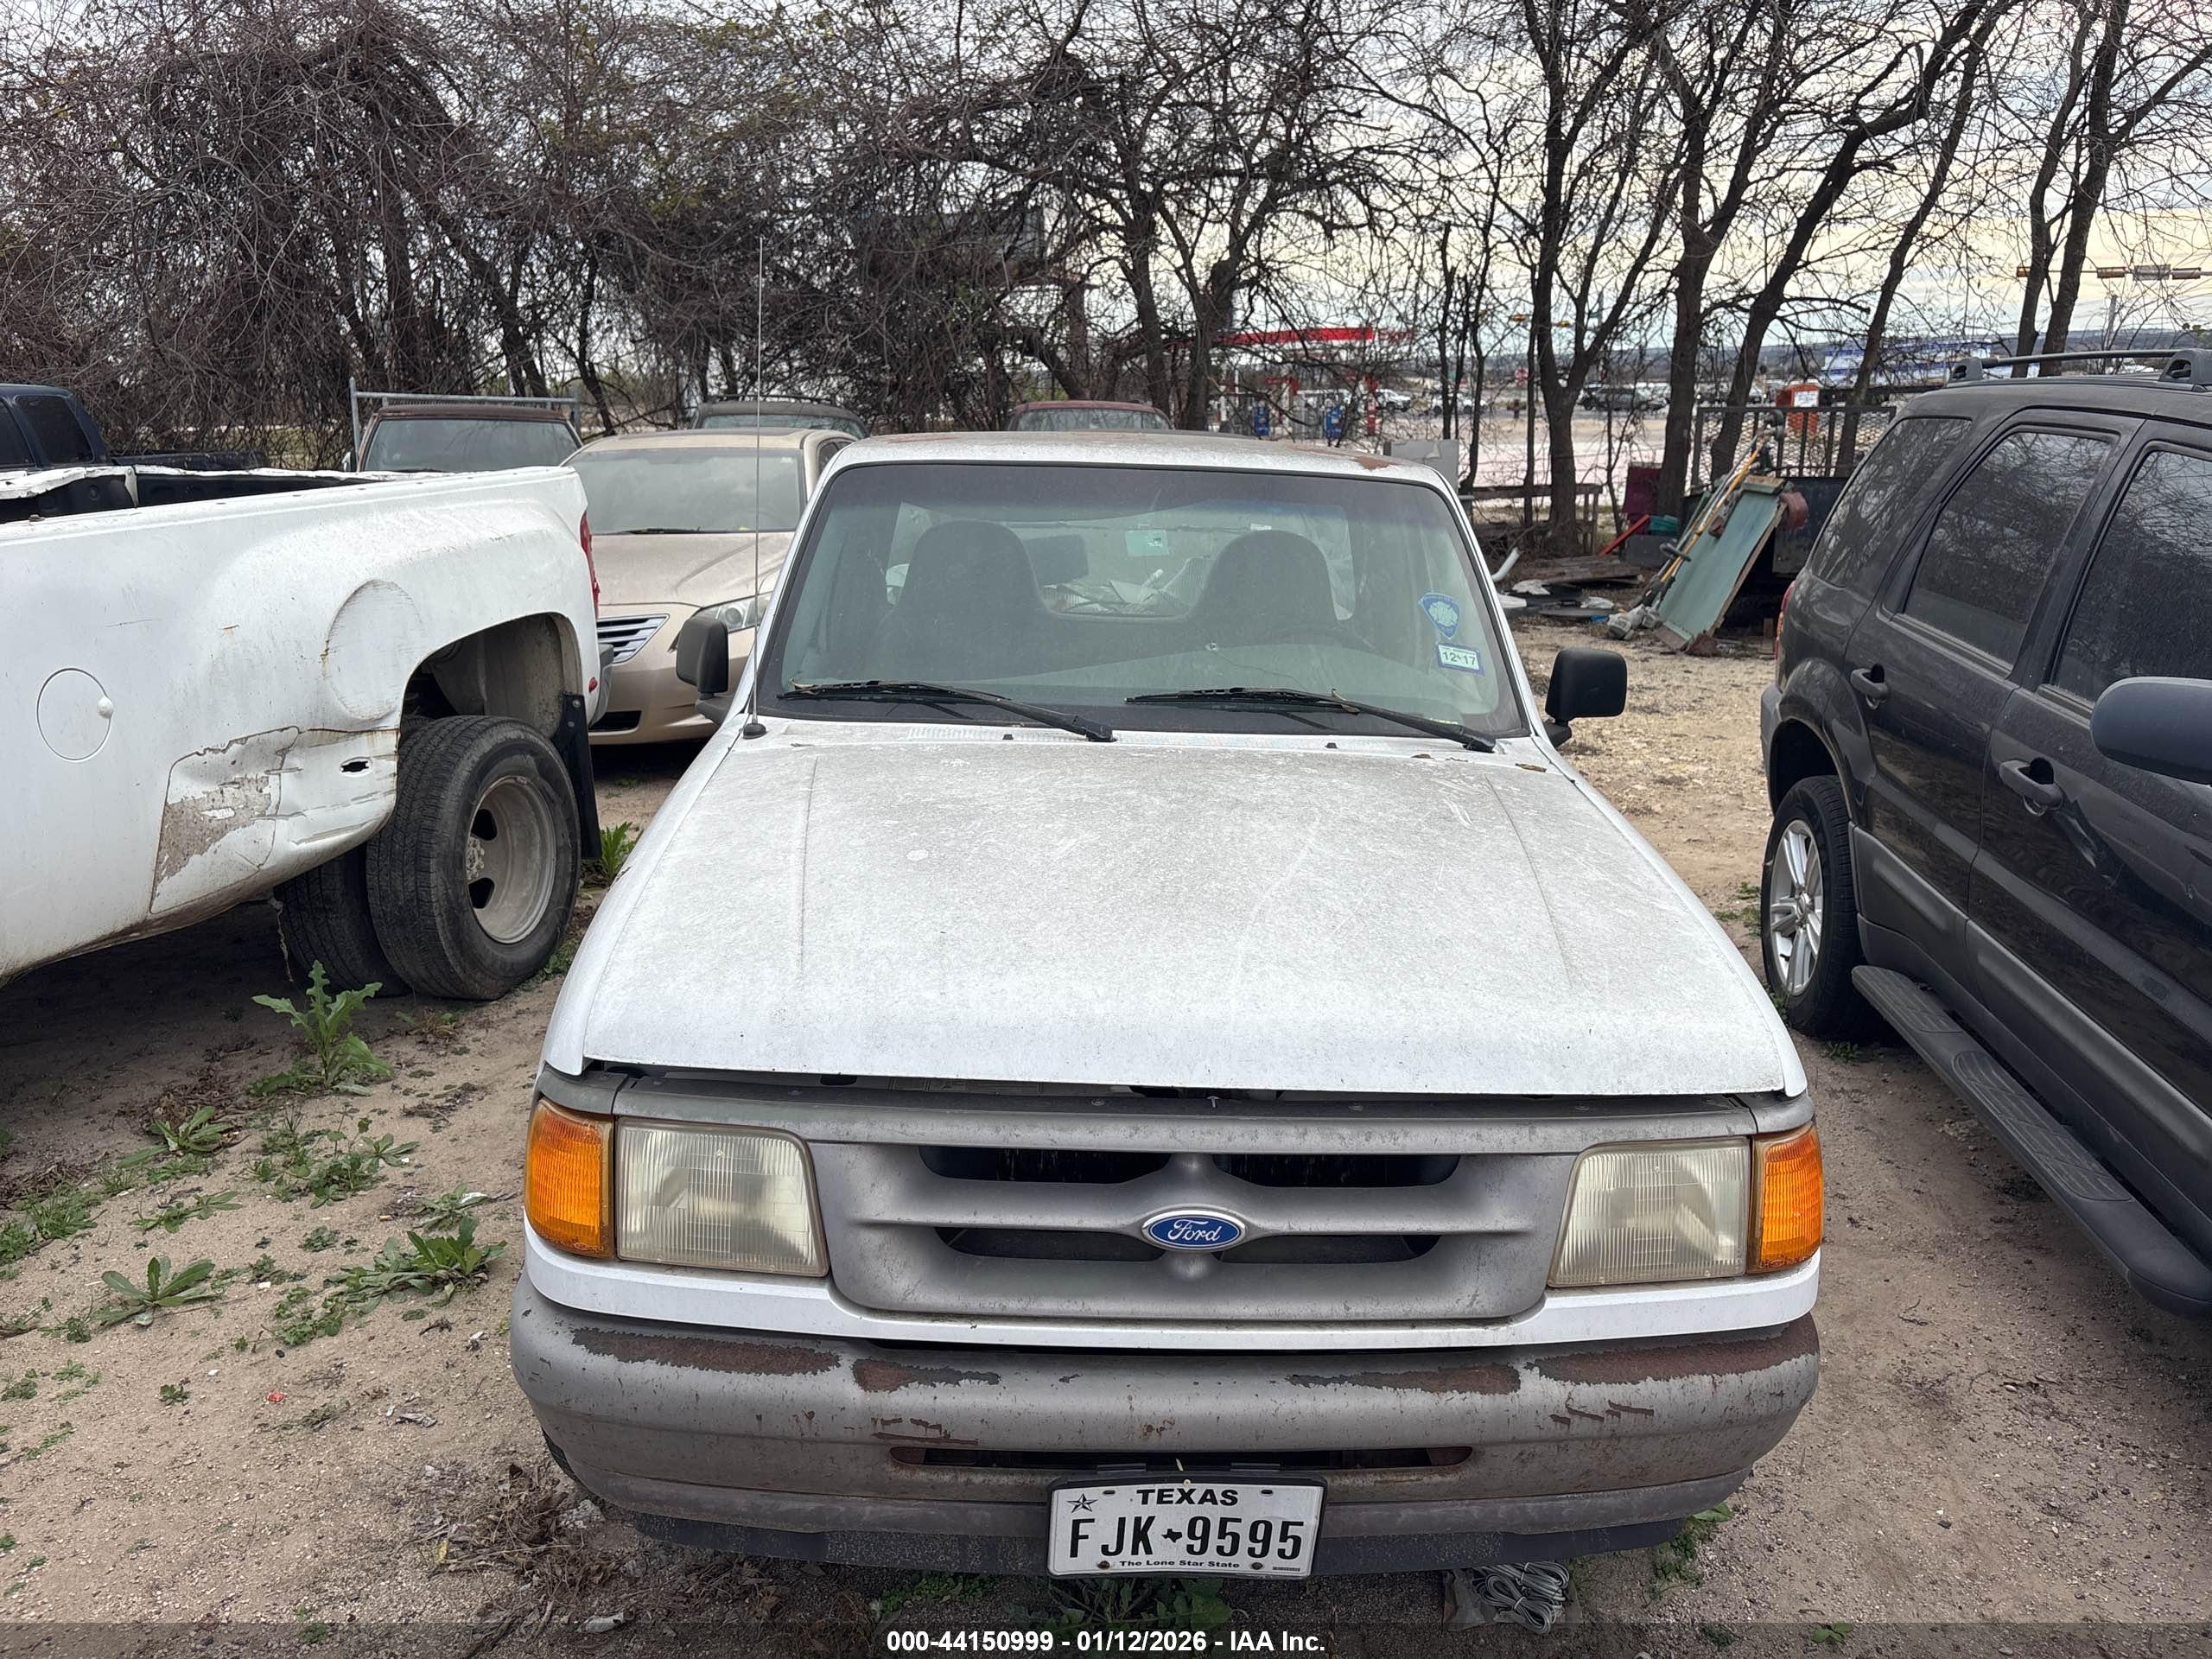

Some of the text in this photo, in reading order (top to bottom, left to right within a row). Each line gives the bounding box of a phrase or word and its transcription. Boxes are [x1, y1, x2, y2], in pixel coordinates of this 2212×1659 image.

[1167, 1219, 1223, 1241] Ford
[1136, 1488, 1238, 1506] TEXAS
[1069, 1516, 1304, 1560] FJK 9595
